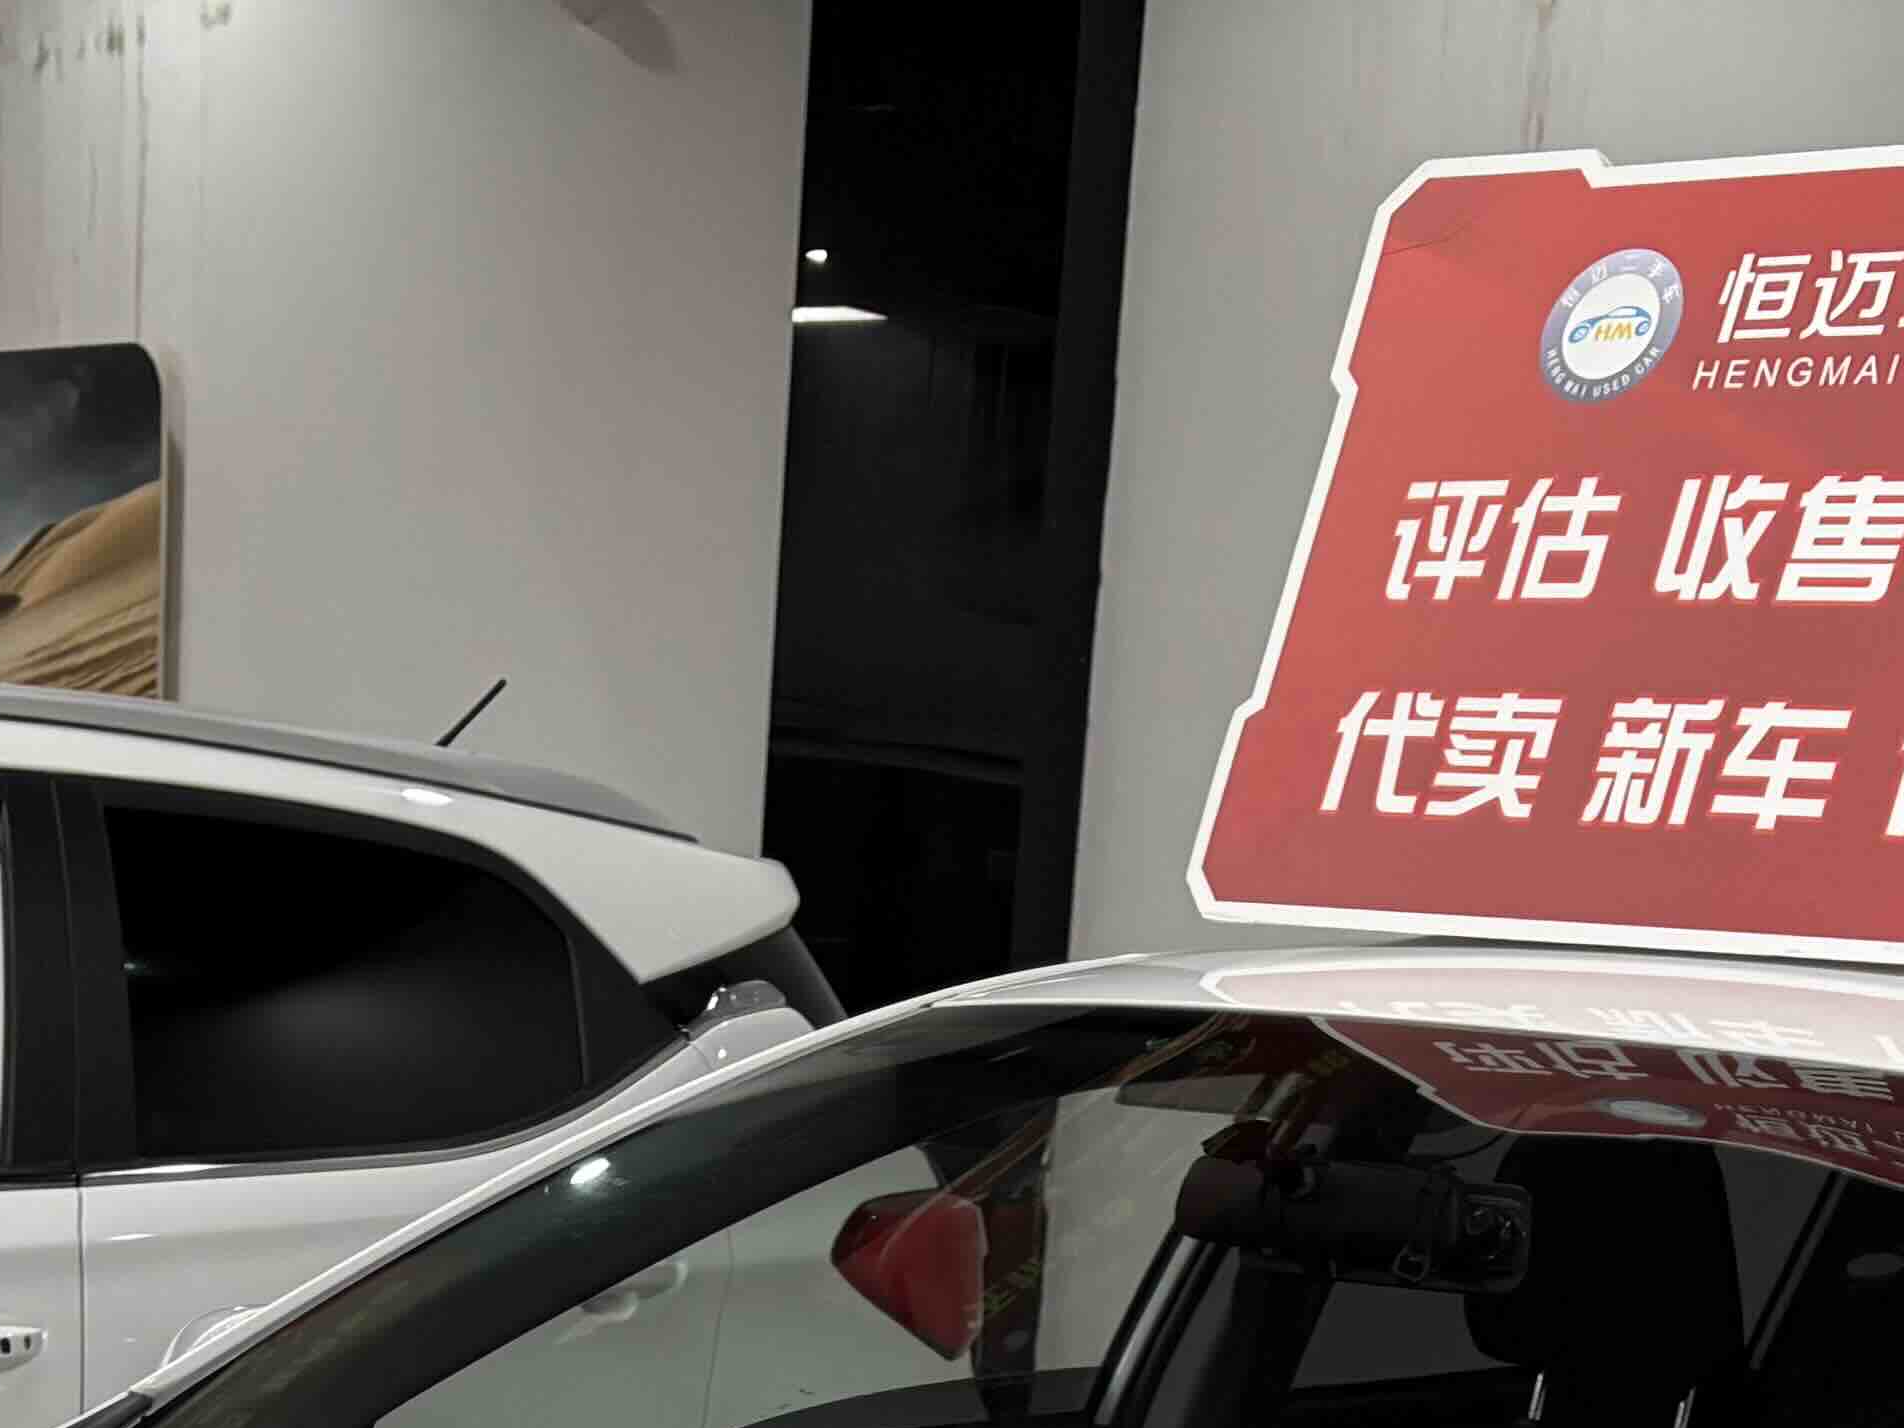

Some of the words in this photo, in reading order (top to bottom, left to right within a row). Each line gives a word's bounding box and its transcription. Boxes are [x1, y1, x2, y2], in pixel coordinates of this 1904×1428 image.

[1693, 354, 1900, 390] HENGMAI
[1385, 477, 1622, 601] 评估
[1320, 691, 1563, 818] 代卖
[1581, 697, 1853, 830] 新车
